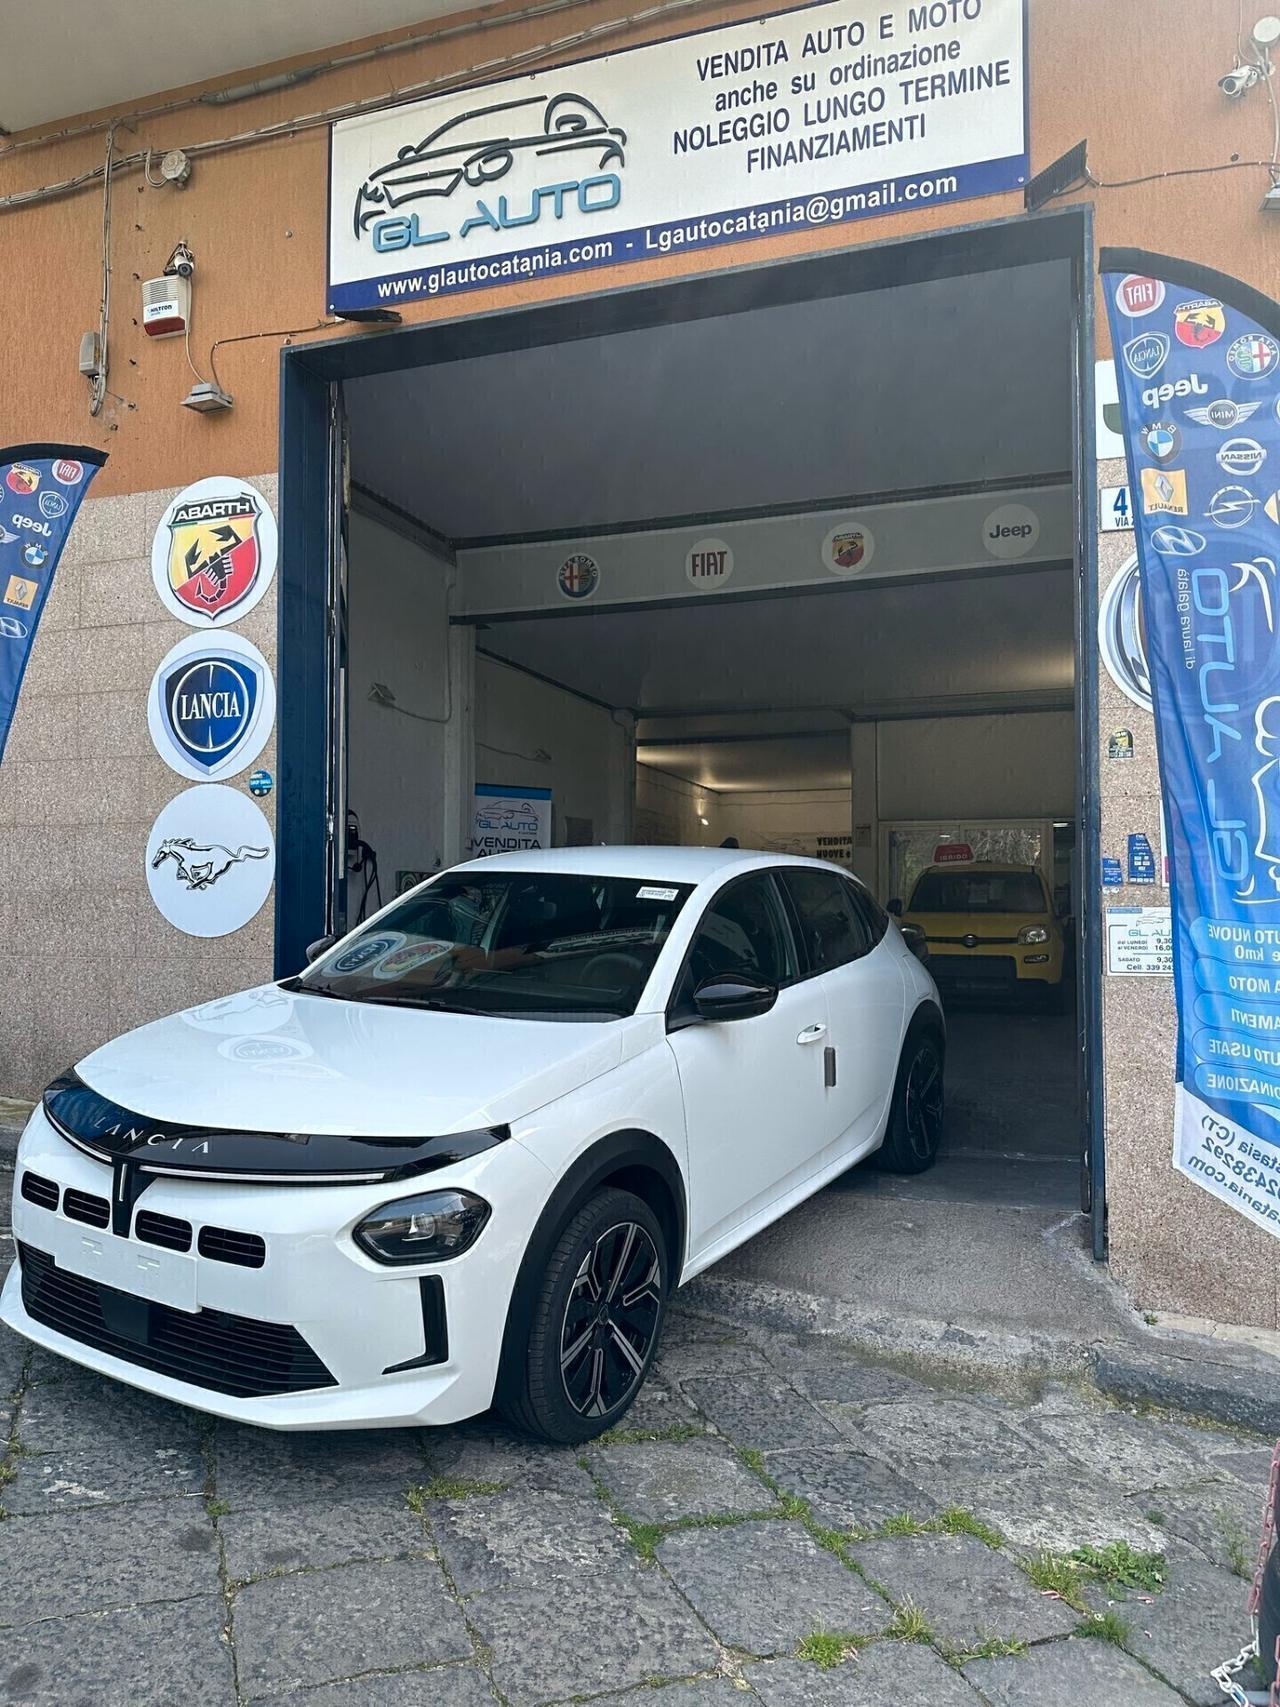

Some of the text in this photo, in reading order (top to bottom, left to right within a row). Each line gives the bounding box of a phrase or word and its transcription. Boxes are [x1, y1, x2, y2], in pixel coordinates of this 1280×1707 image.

[697, 0, 981, 81] VENDITA AUTO E MOTO
[715, 40, 961, 111] anche su ordinazione
[674, 60, 1011, 154] NOLEGGIO LUNGO TERMINE
[747, 113, 926, 173] FINANZIAMENTI
[372, 173, 621, 252] GL AUTO
[377, 241, 613, 298] www.glautocatania.com
[646, 174, 957, 251] Lgautocatania@gmail.com
[176, 502, 250, 522] ABARTH
[1115, 517, 1129, 527] VIA
[989, 524, 1032, 539] Jeep
[692, 551, 727, 577] FIAT
[180, 692, 241, 720] LANCIA
[478, 820, 538, 831] GL AUTO
[473, 837, 541, 849] VENDITA
[816, 836, 852, 846] VENDITA
[94, 1116, 209, 1153] LANCIA
